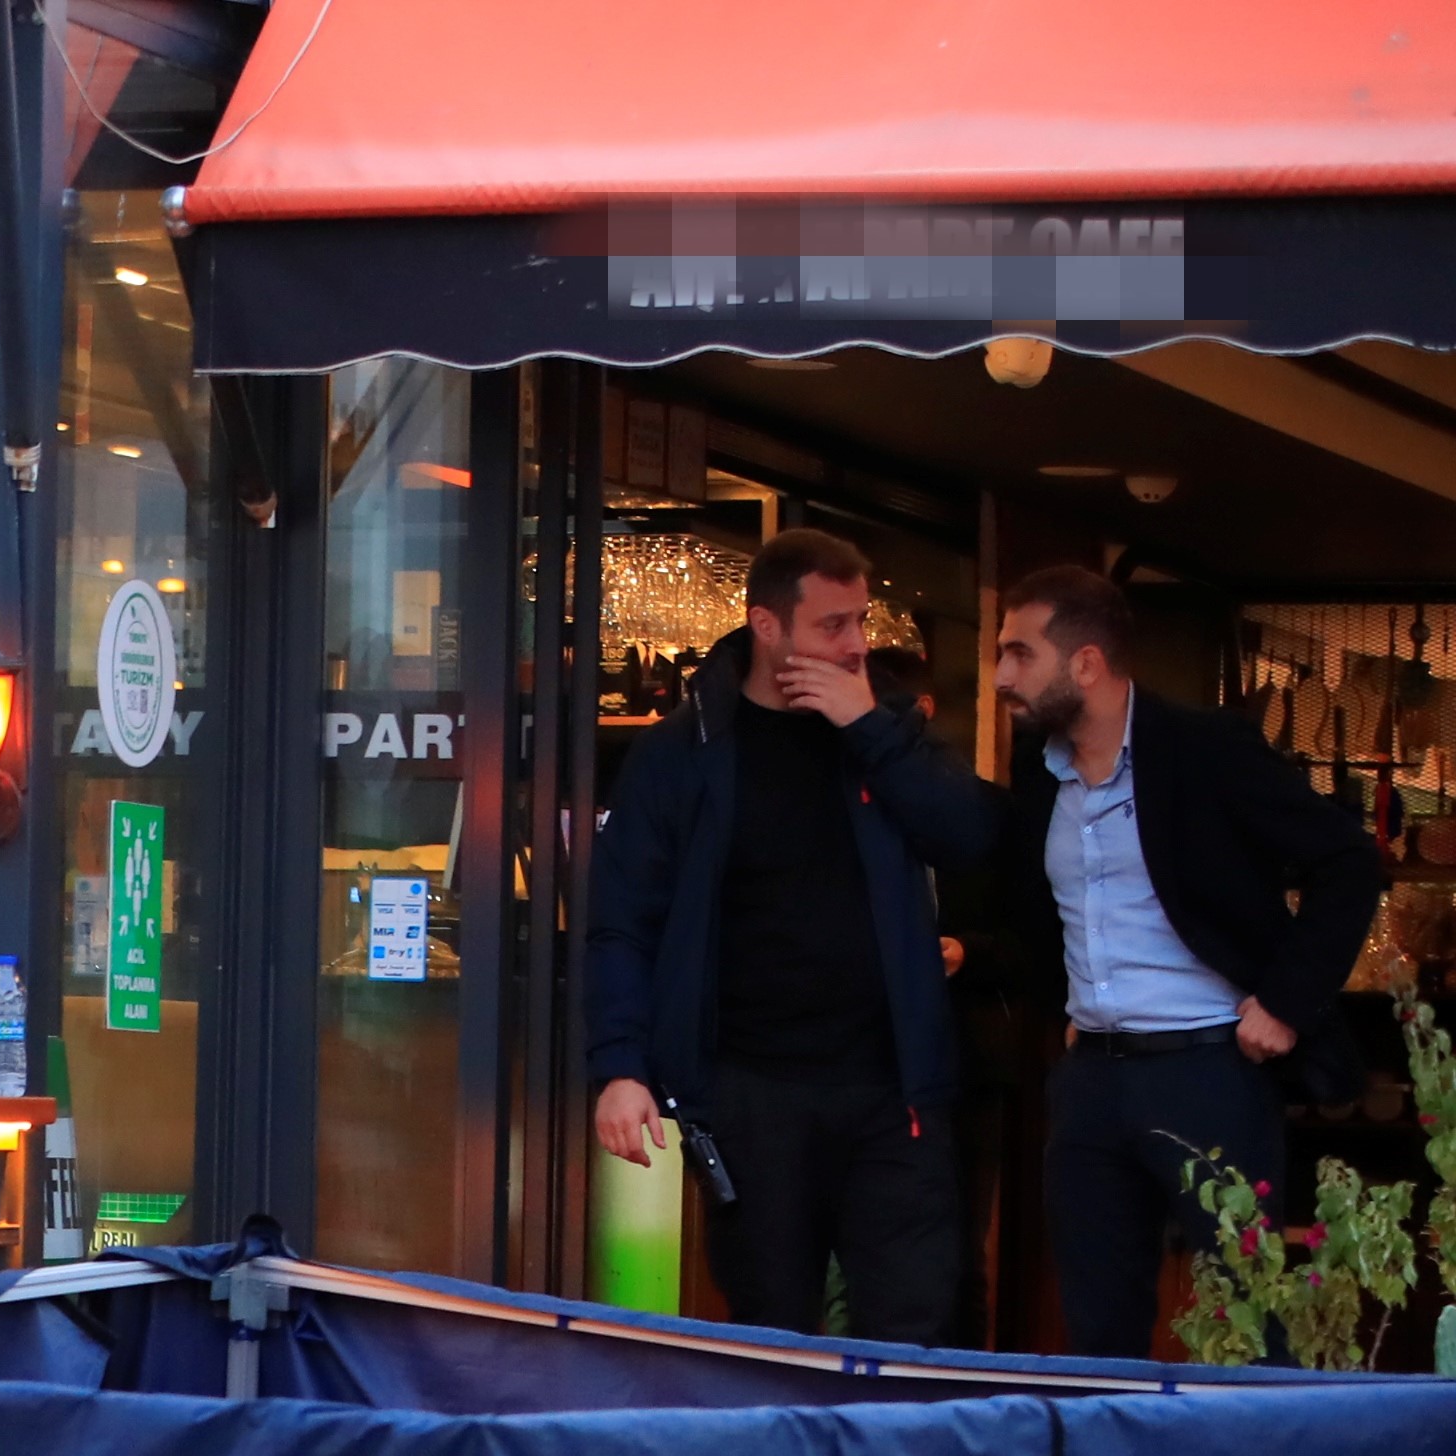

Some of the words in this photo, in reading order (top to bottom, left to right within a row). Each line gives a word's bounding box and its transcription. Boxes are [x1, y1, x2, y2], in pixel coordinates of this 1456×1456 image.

[121, 668, 154, 687] TURİZM
[126, 945, 146, 965] ACİL
[113, 974, 156, 993] TOPLANMA
[124, 1003, 149, 1020] ALANI
